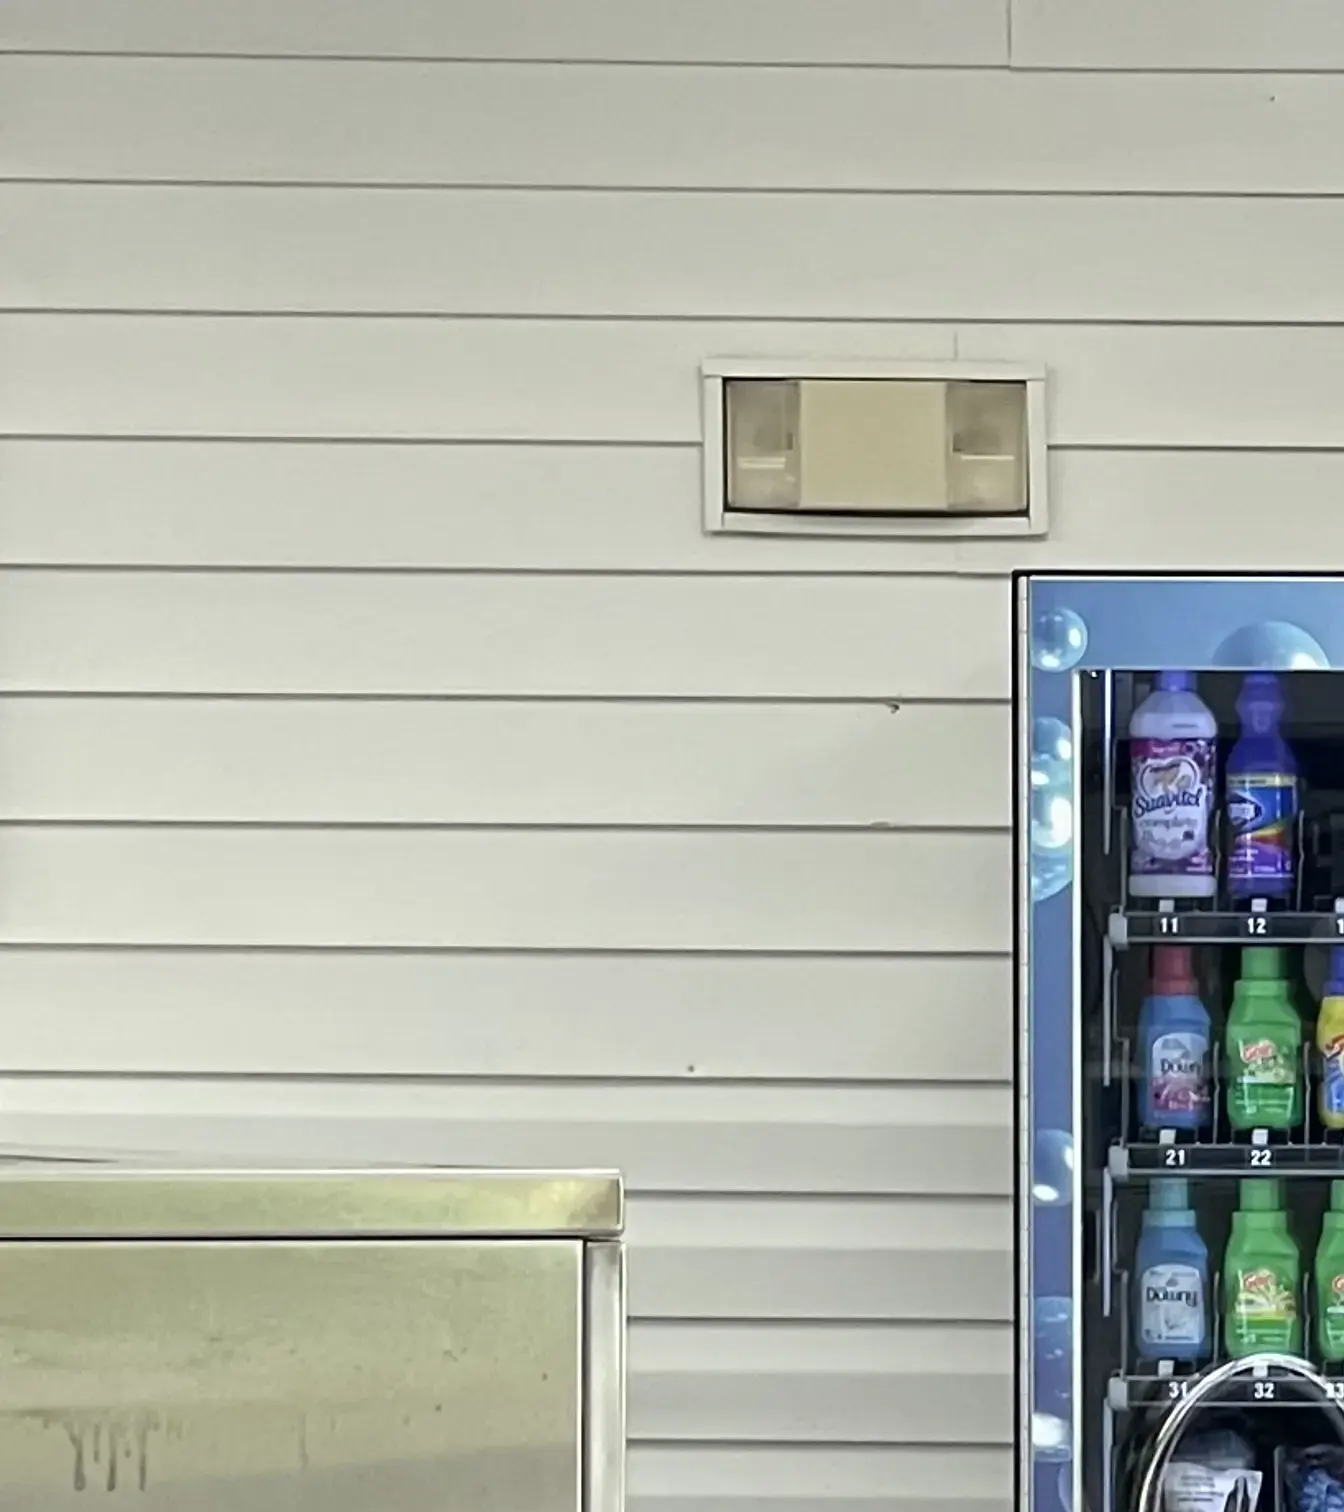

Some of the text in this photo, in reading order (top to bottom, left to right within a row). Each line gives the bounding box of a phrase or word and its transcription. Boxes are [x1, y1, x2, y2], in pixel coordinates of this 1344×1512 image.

[1160, 918, 1179, 934] 11
[1247, 918, 1267, 934] 12
[1165, 1149, 1185, 1166] 21
[1250, 1149, 1272, 1166] 22
[1168, 1381, 1188, 1398] 31
[1254, 1382, 1274, 1399] 32
